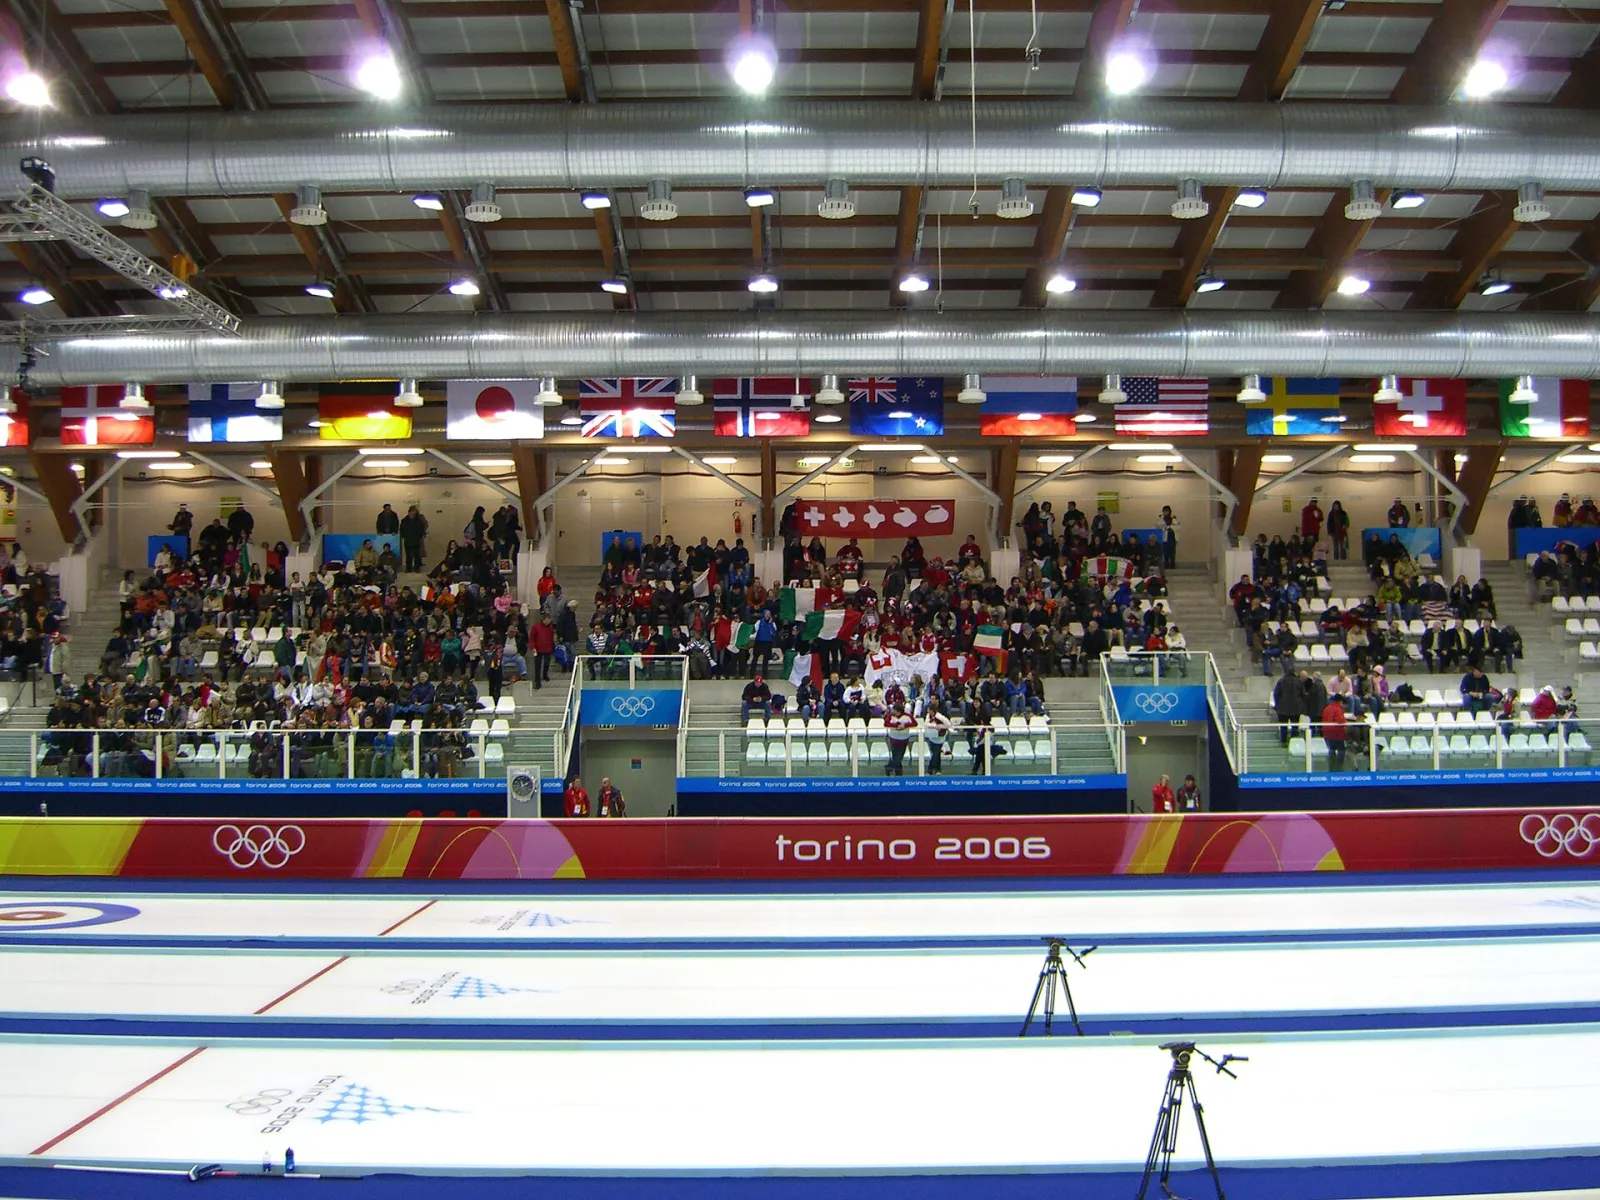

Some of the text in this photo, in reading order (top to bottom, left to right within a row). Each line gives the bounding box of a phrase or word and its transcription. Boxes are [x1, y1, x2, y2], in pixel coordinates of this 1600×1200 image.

[776, 834, 1051, 861] torino 2006
[260, 1074, 345, 1134] torino 2006
